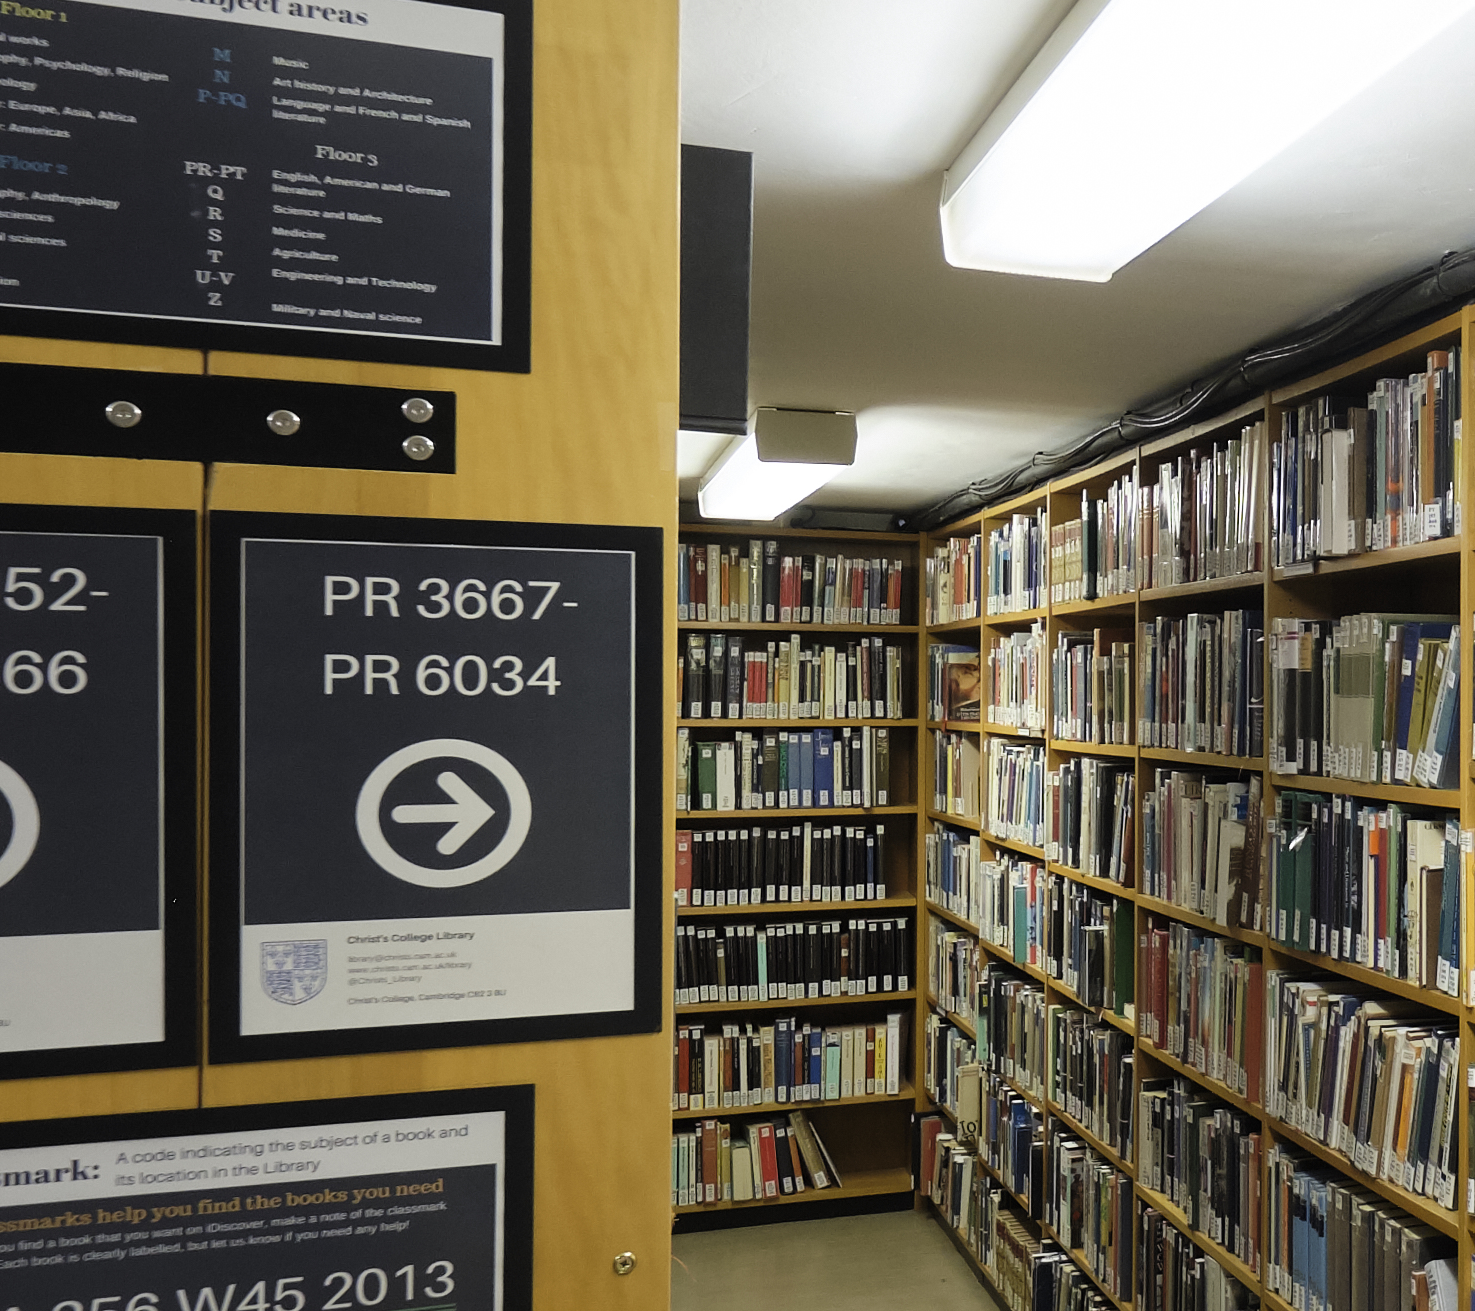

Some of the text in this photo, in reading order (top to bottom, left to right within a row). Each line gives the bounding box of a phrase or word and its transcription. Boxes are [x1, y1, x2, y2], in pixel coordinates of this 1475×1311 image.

[0, 0, 68, 23] Floor 1
[288, 0, 369, 27] areas
[8, 33, 50, 47] works
[212, 47, 232, 63] M
[272, 55, 309, 70] Music
[214, 70, 231, 84] N
[196, 89, 248, 109] P-PQ
[315, 145, 379, 167] Floor 3
[55, 163, 69, 175] 2
[183, 161, 247, 180] PR-PT
[207, 186, 225, 201] Q
[207, 207, 224, 221] R
[207, 229, 222, 242] S
[207, 249, 223, 263] T
[194, 269, 235, 286] U-V
[207, 293, 222, 307] Z
[324, 575, 579, 621] PR 3667-
[324, 654, 562, 697] PR 6034
[347, 931, 475, 945] Christ's College Library
[115, 1125, 468, 1165] A code indicating the subject of a book and
[115, 1158, 321, 1187] its location in the Library
[97, 1206, 147, 1225] help
[150, 1202, 192, 1222] you
[198, 1197, 241, 1216] find
[245, 1194, 282, 1211] the
[285, 1189, 348, 1207] books
[352, 1185, 391, 1204] you
[395, 1178, 444, 1195] need
[321, 1260, 456, 1311] 2013
